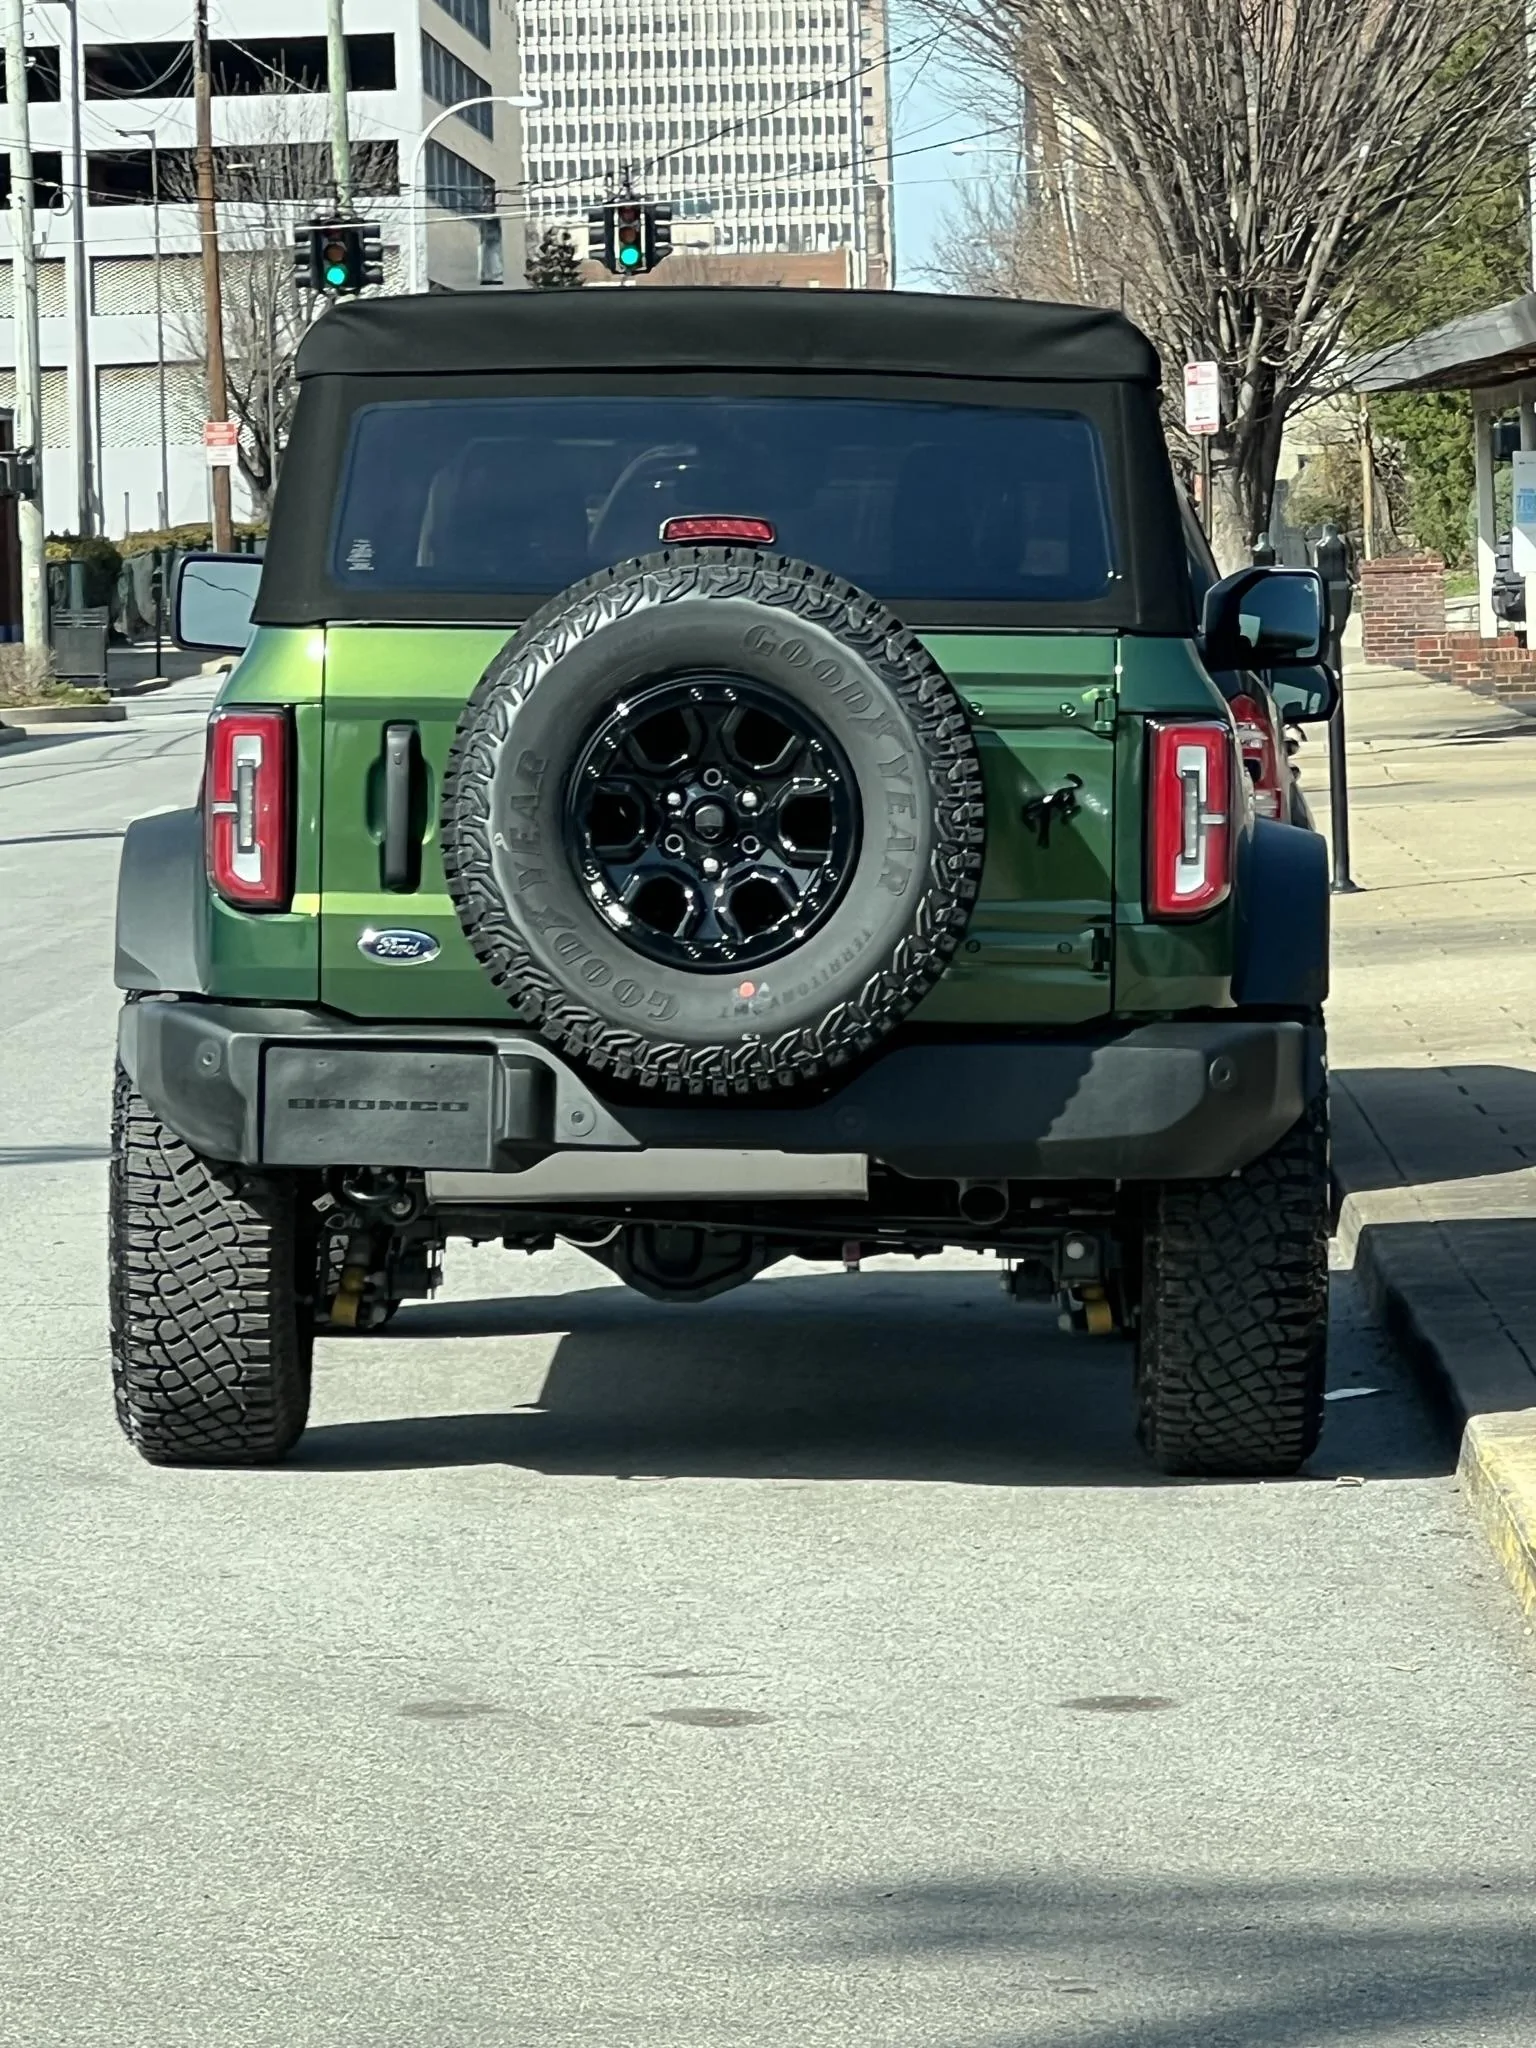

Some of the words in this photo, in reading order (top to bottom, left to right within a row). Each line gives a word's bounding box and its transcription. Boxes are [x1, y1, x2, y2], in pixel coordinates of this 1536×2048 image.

[506, 749, 680, 1023] GOODYEAR
[741, 624, 918, 898] GOODYEAR
[287, 1097, 469, 1113] BRONCO
